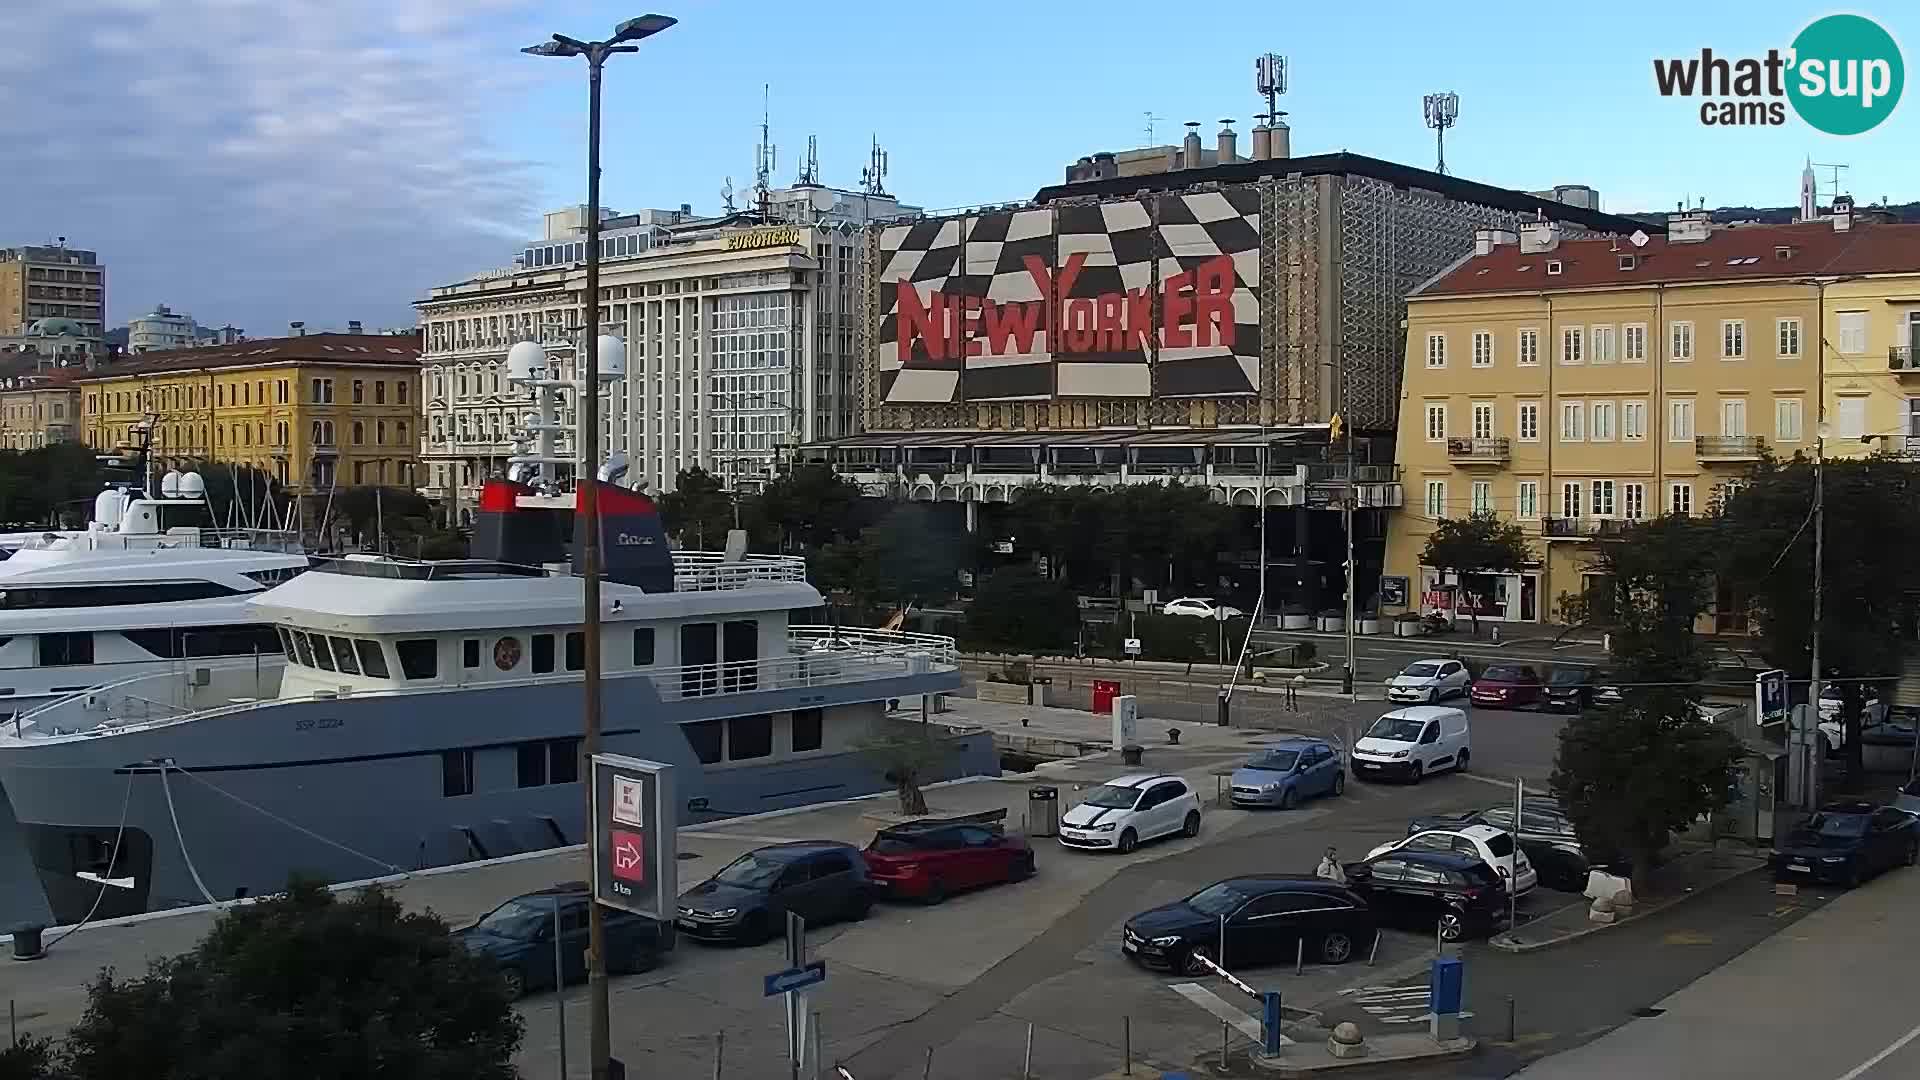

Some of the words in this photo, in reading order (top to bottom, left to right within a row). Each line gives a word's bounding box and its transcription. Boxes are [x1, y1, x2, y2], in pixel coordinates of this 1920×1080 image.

[897, 276, 1041, 362] NEW
[1023, 251, 1237, 354] YORKER
[1767, 678, 1779, 702] P
